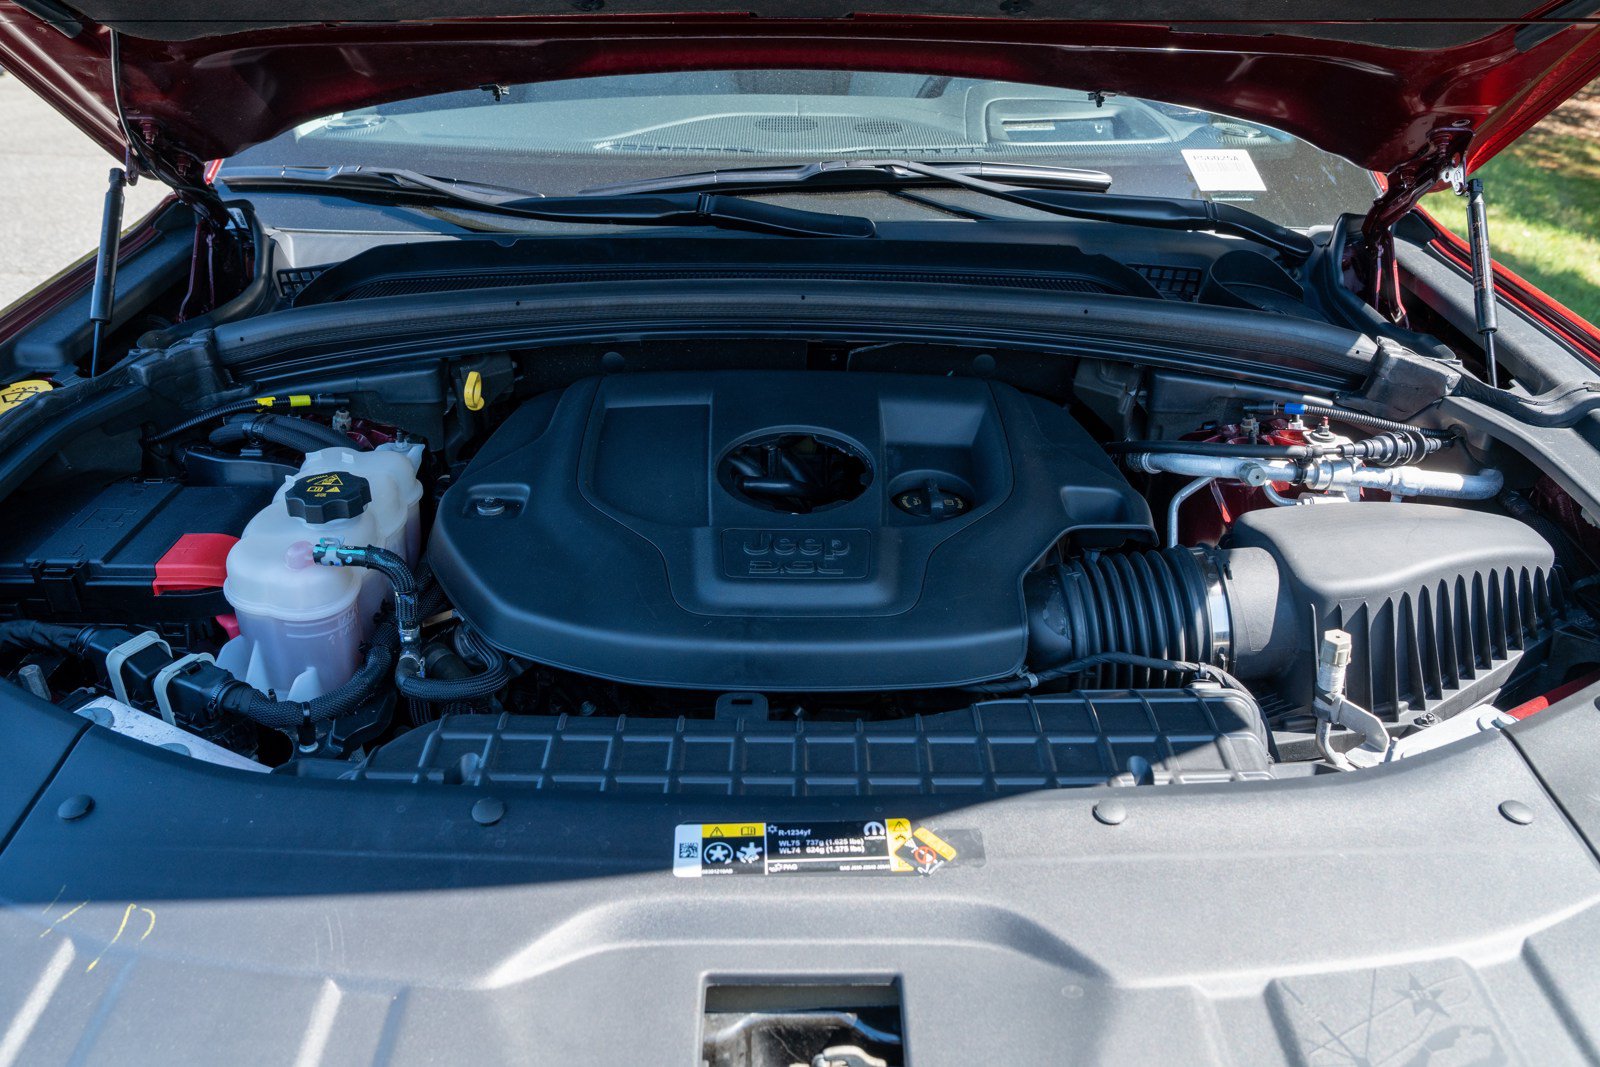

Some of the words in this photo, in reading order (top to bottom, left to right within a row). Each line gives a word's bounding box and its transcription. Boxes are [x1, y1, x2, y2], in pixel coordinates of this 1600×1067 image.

[743, 531, 851, 560] Jeep
[778, 828, 812, 838] R-1234yf
[779, 847, 801, 855] WL74
